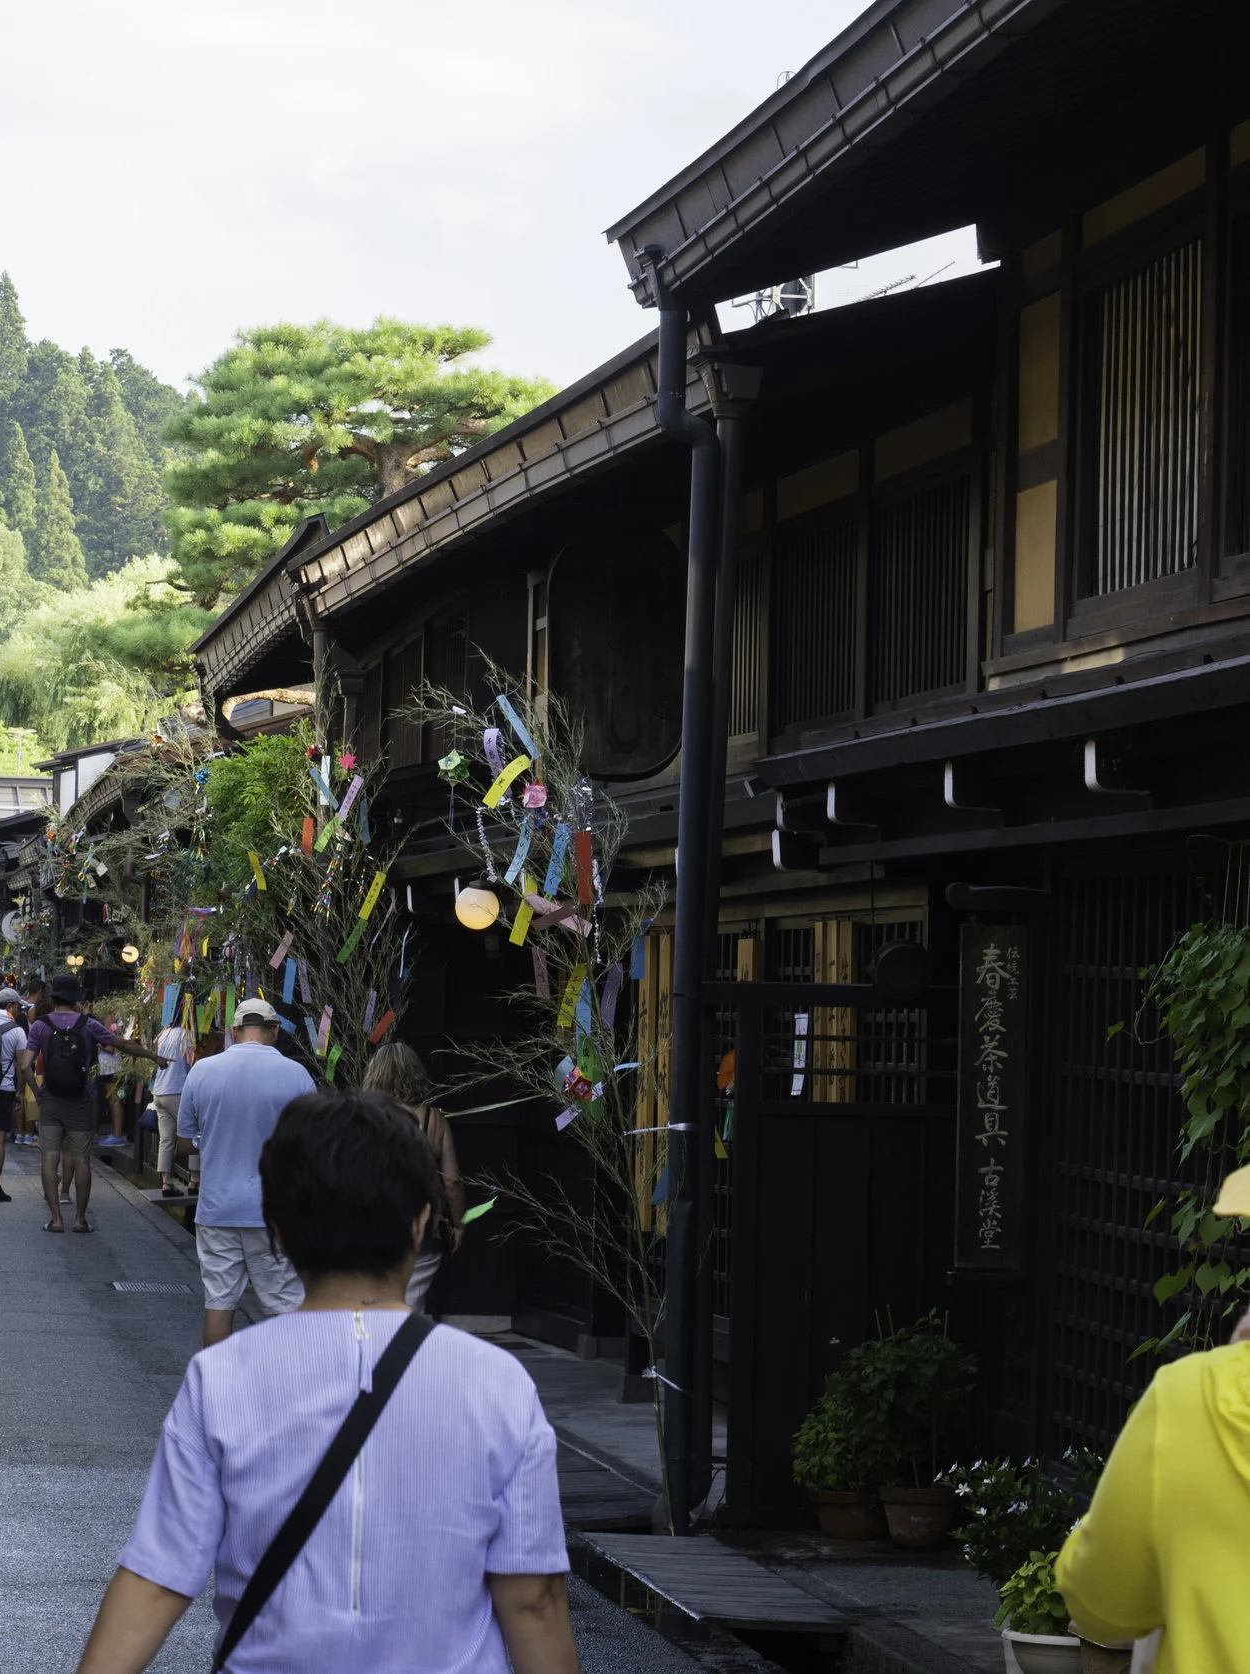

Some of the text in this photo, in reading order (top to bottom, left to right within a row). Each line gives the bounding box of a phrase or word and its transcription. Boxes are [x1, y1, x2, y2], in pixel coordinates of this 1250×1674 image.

[1005, 945, 1021, 1001] 伝統工芸
[974, 944, 1012, 1147] 春慶茶道具
